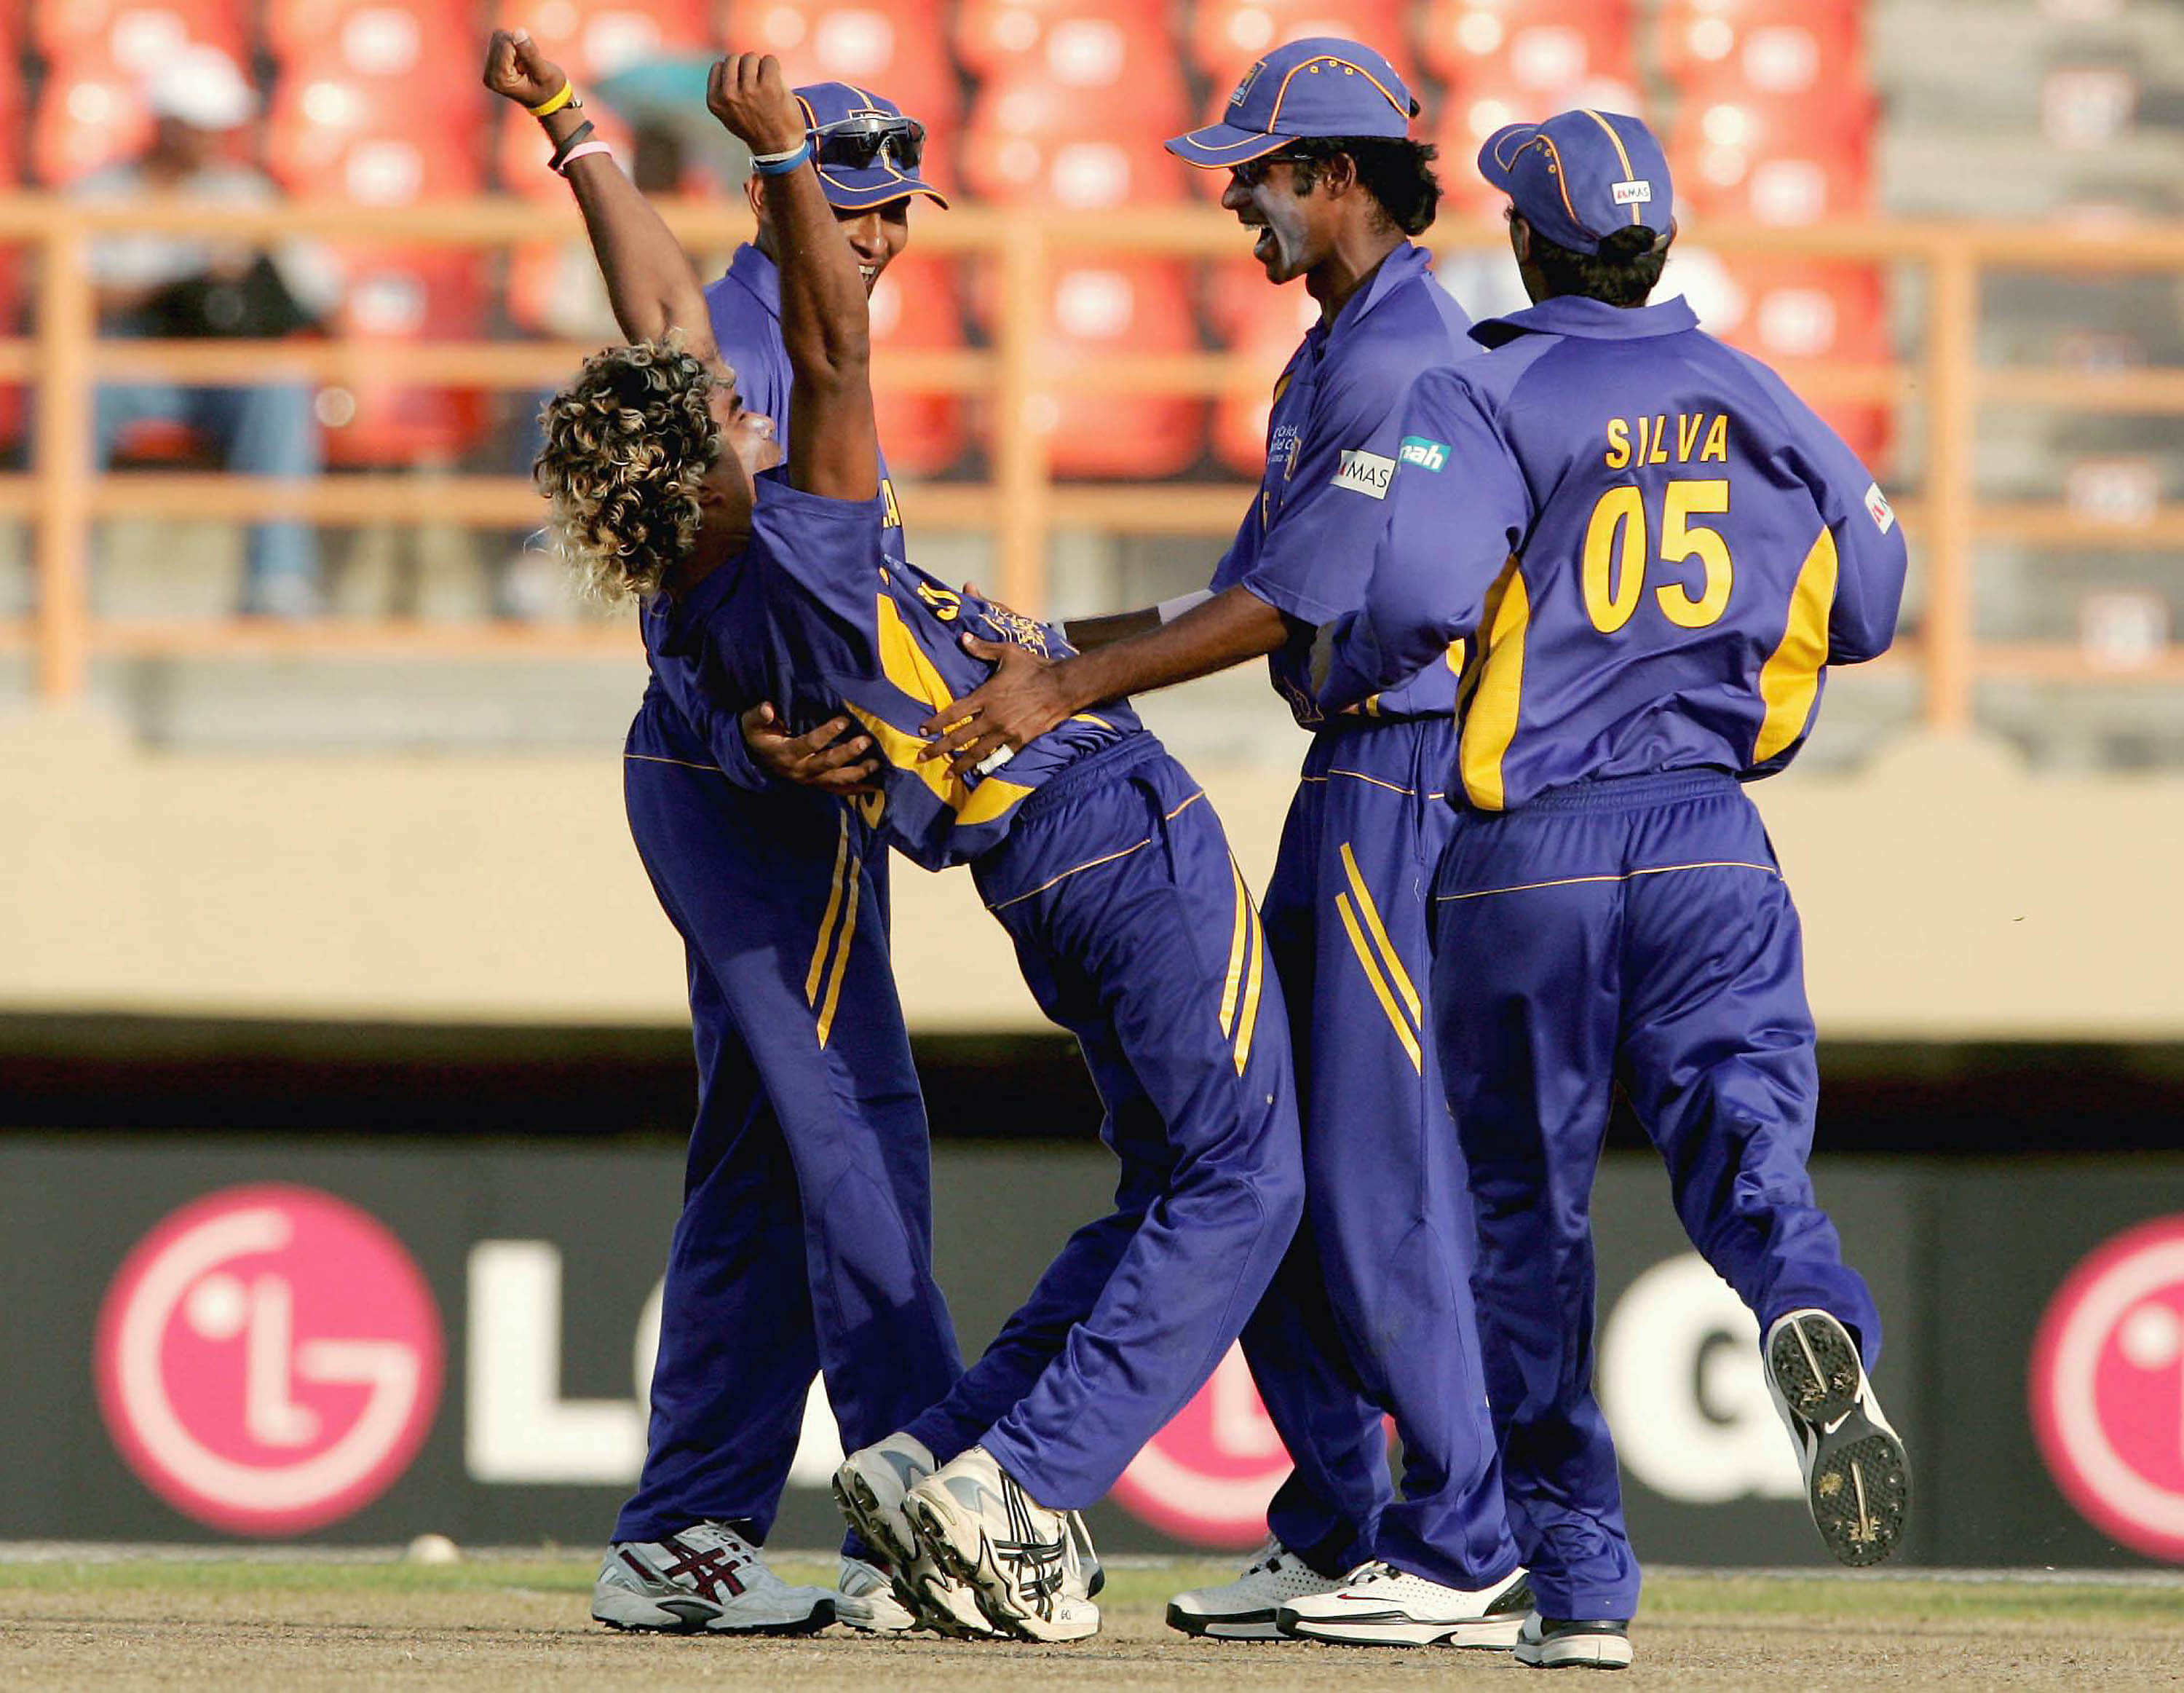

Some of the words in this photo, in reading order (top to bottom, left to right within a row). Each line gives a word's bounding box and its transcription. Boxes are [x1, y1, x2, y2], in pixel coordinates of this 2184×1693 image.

[1346, 460, 1389, 489] MAS
[1605, 413, 1728, 469] SILVA
[1582, 478, 1733, 634] 05
[111, 1199, 425, 1516] LG
